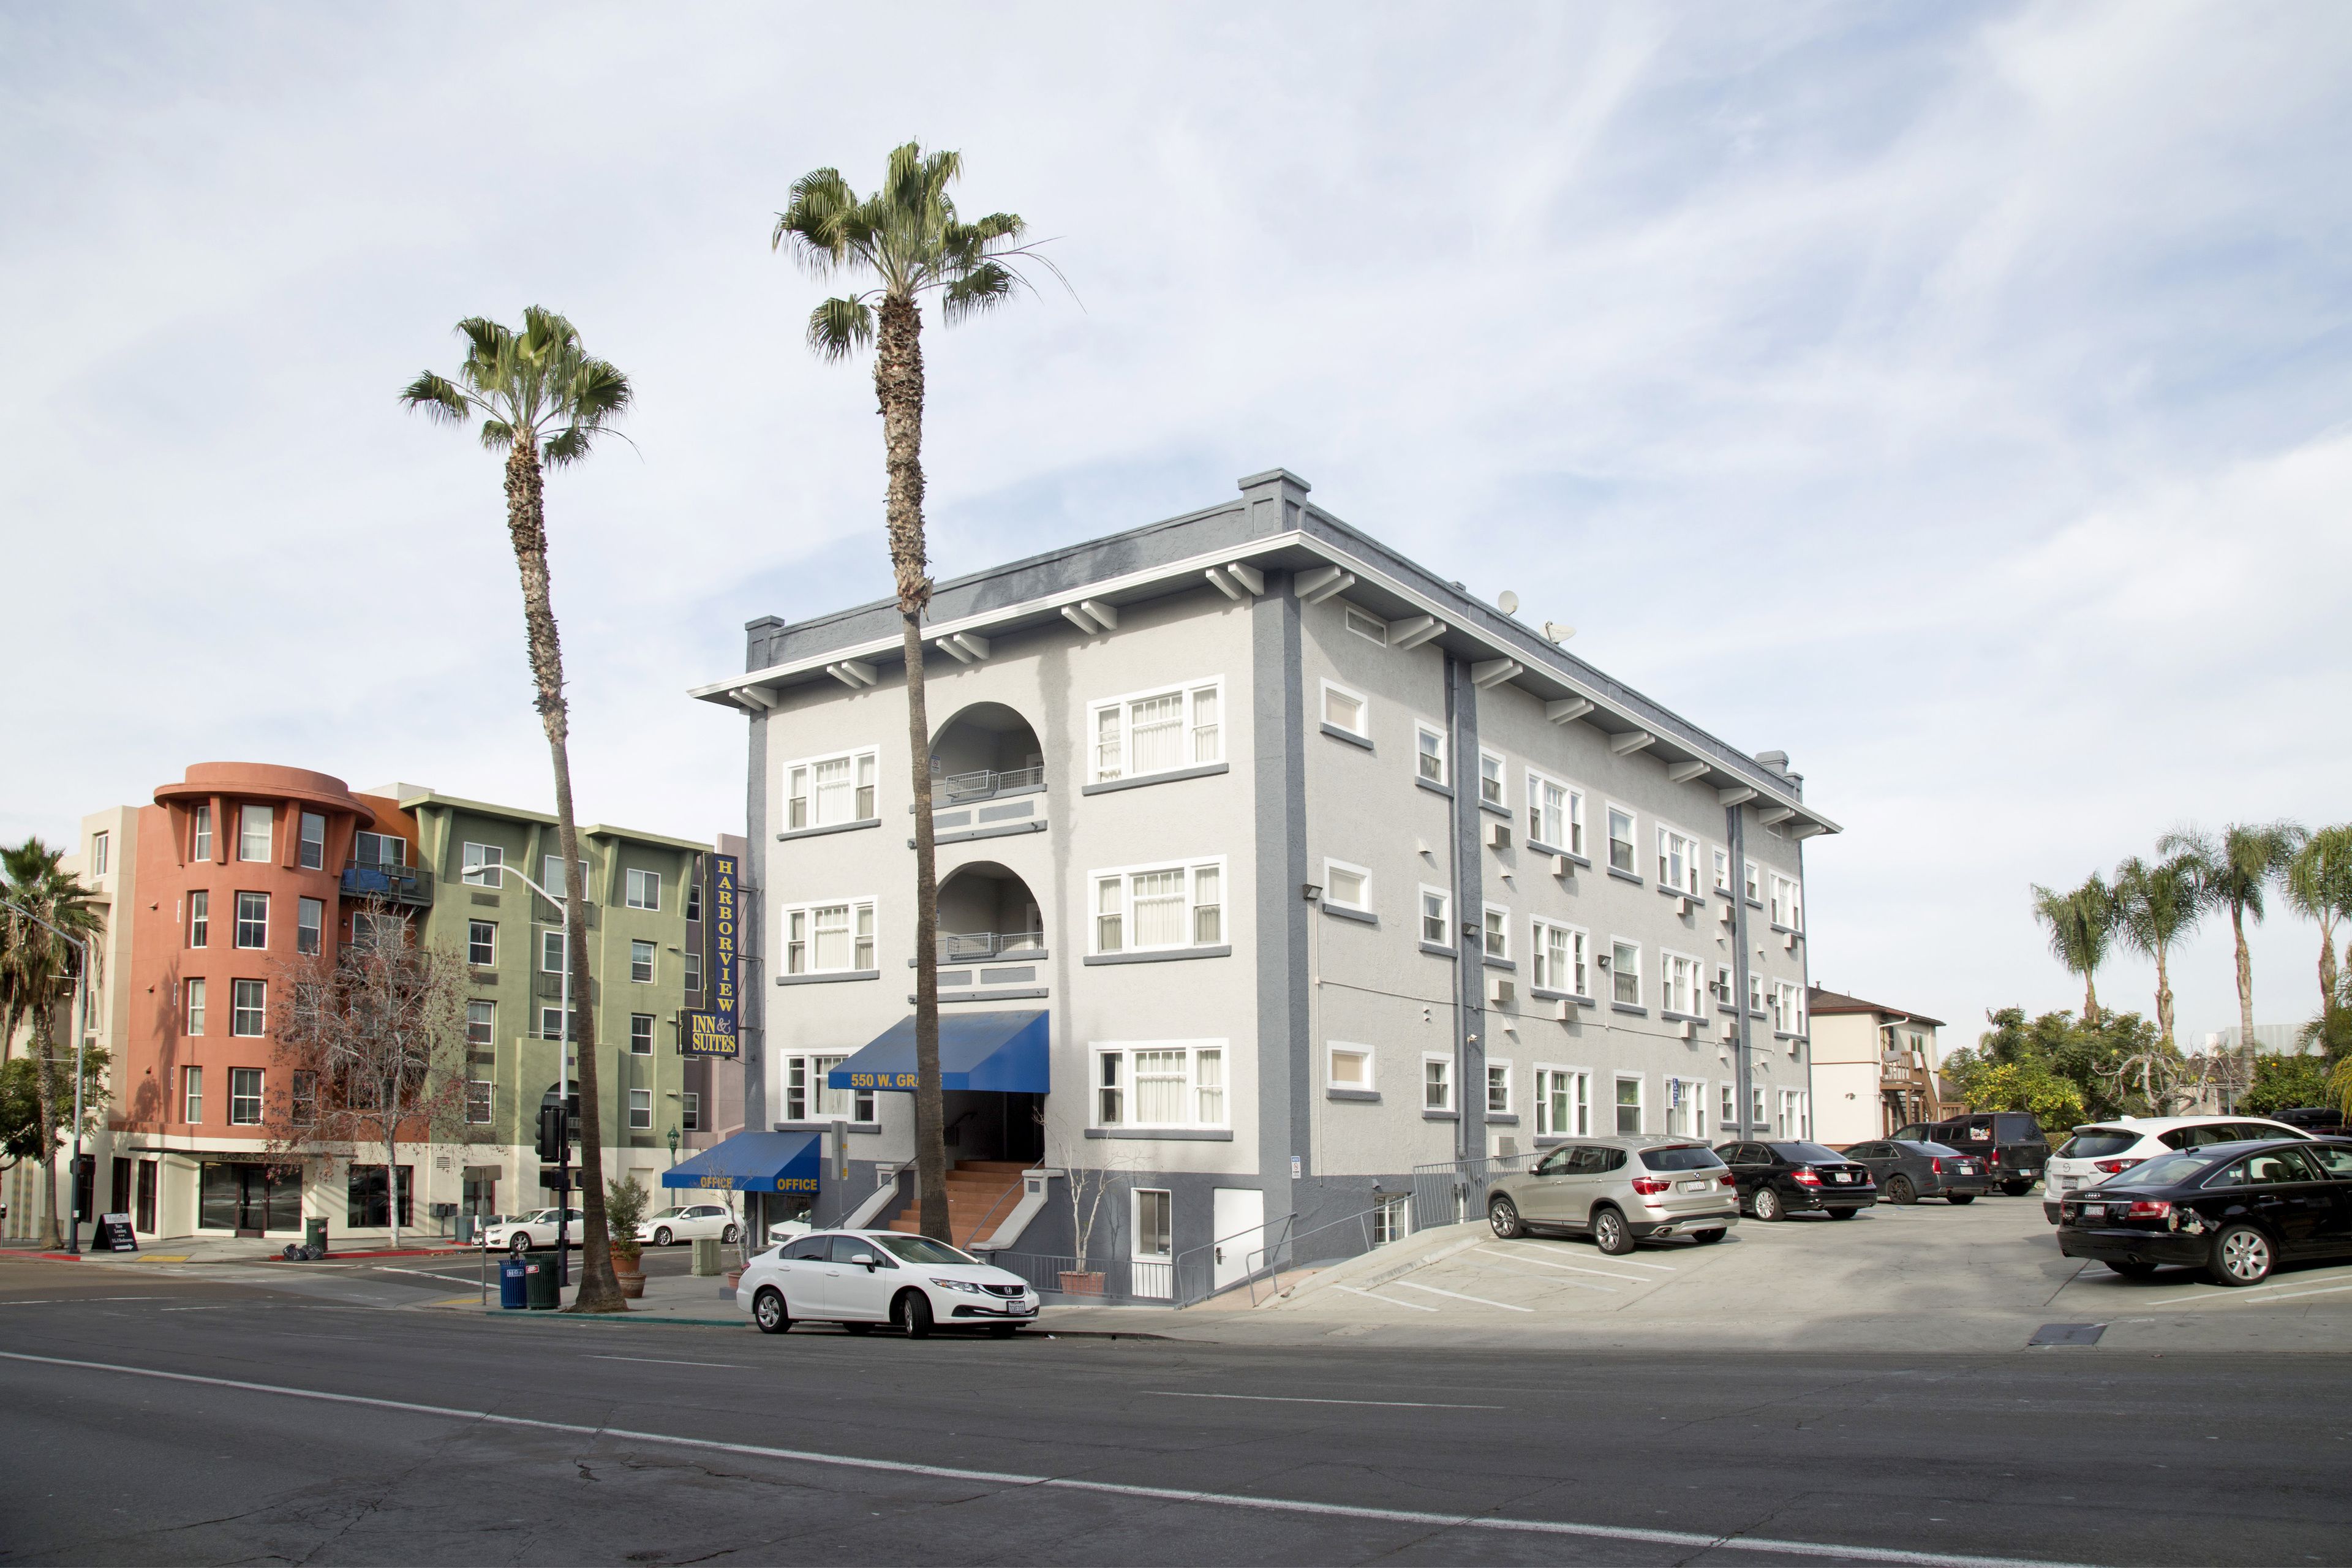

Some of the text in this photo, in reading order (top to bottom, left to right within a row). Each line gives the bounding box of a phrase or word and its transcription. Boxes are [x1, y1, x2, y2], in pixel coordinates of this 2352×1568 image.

[717, 860, 734, 1012] HARBORVIEW
[692, 1014, 731, 1035] INN &
[693, 1032, 736, 1053] SUITES
[851, 1074, 874, 1087] 550
[877, 1074, 892, 1087] W.
[700, 1177, 733, 1188] OFFICE
[777, 1178, 818, 1191] OFFICE
